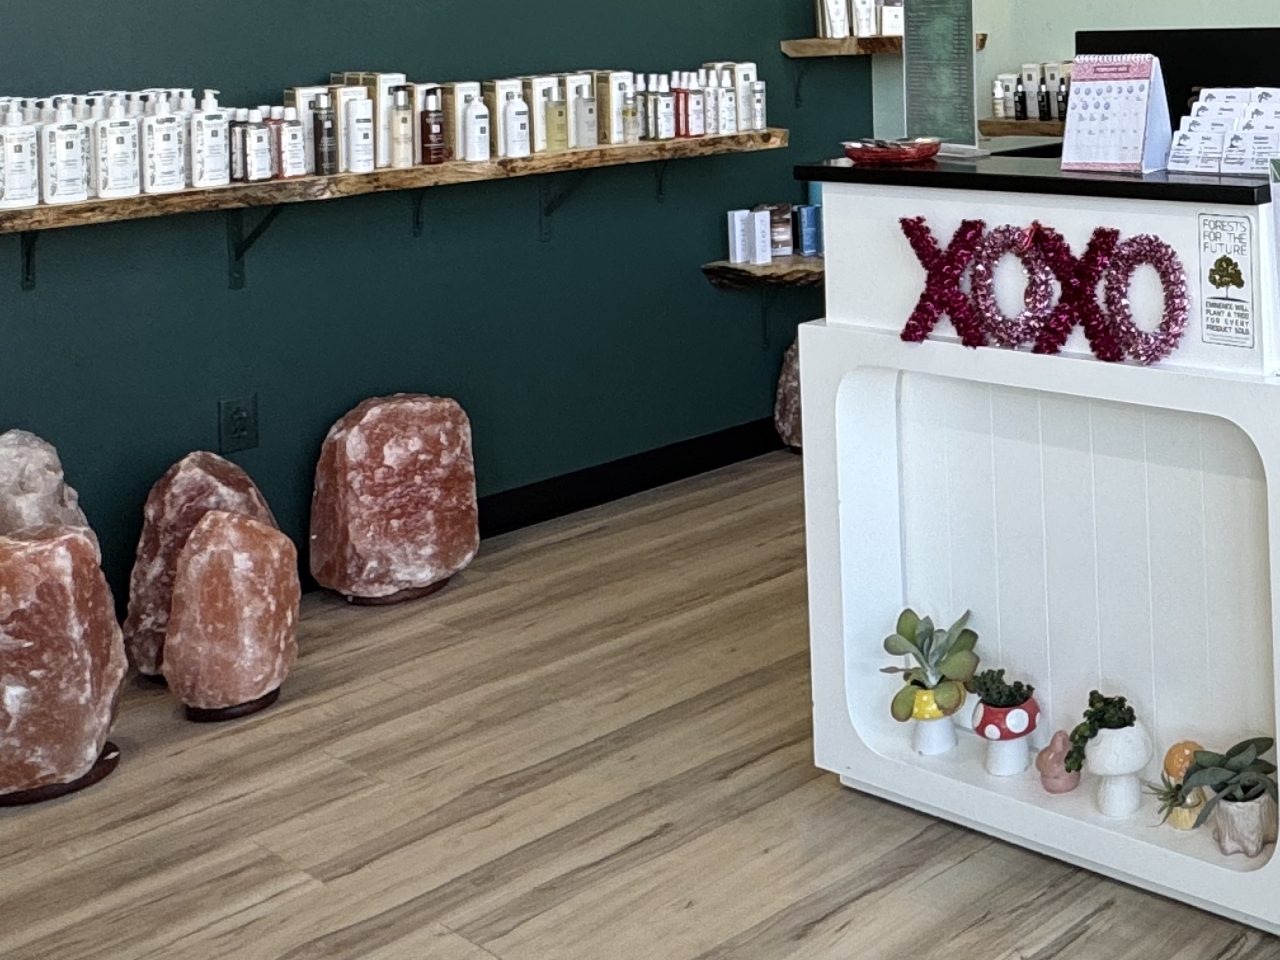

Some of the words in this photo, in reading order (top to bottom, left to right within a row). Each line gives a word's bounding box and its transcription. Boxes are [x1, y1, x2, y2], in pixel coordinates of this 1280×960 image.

[1202, 218, 1247, 233] FORESTS
[1202, 230, 1221, 242] FOR
[1227, 232, 1247, 245] THE
[1202, 241, 1247, 256] FUTURE
[899, 216, 1192, 365] XOXO
